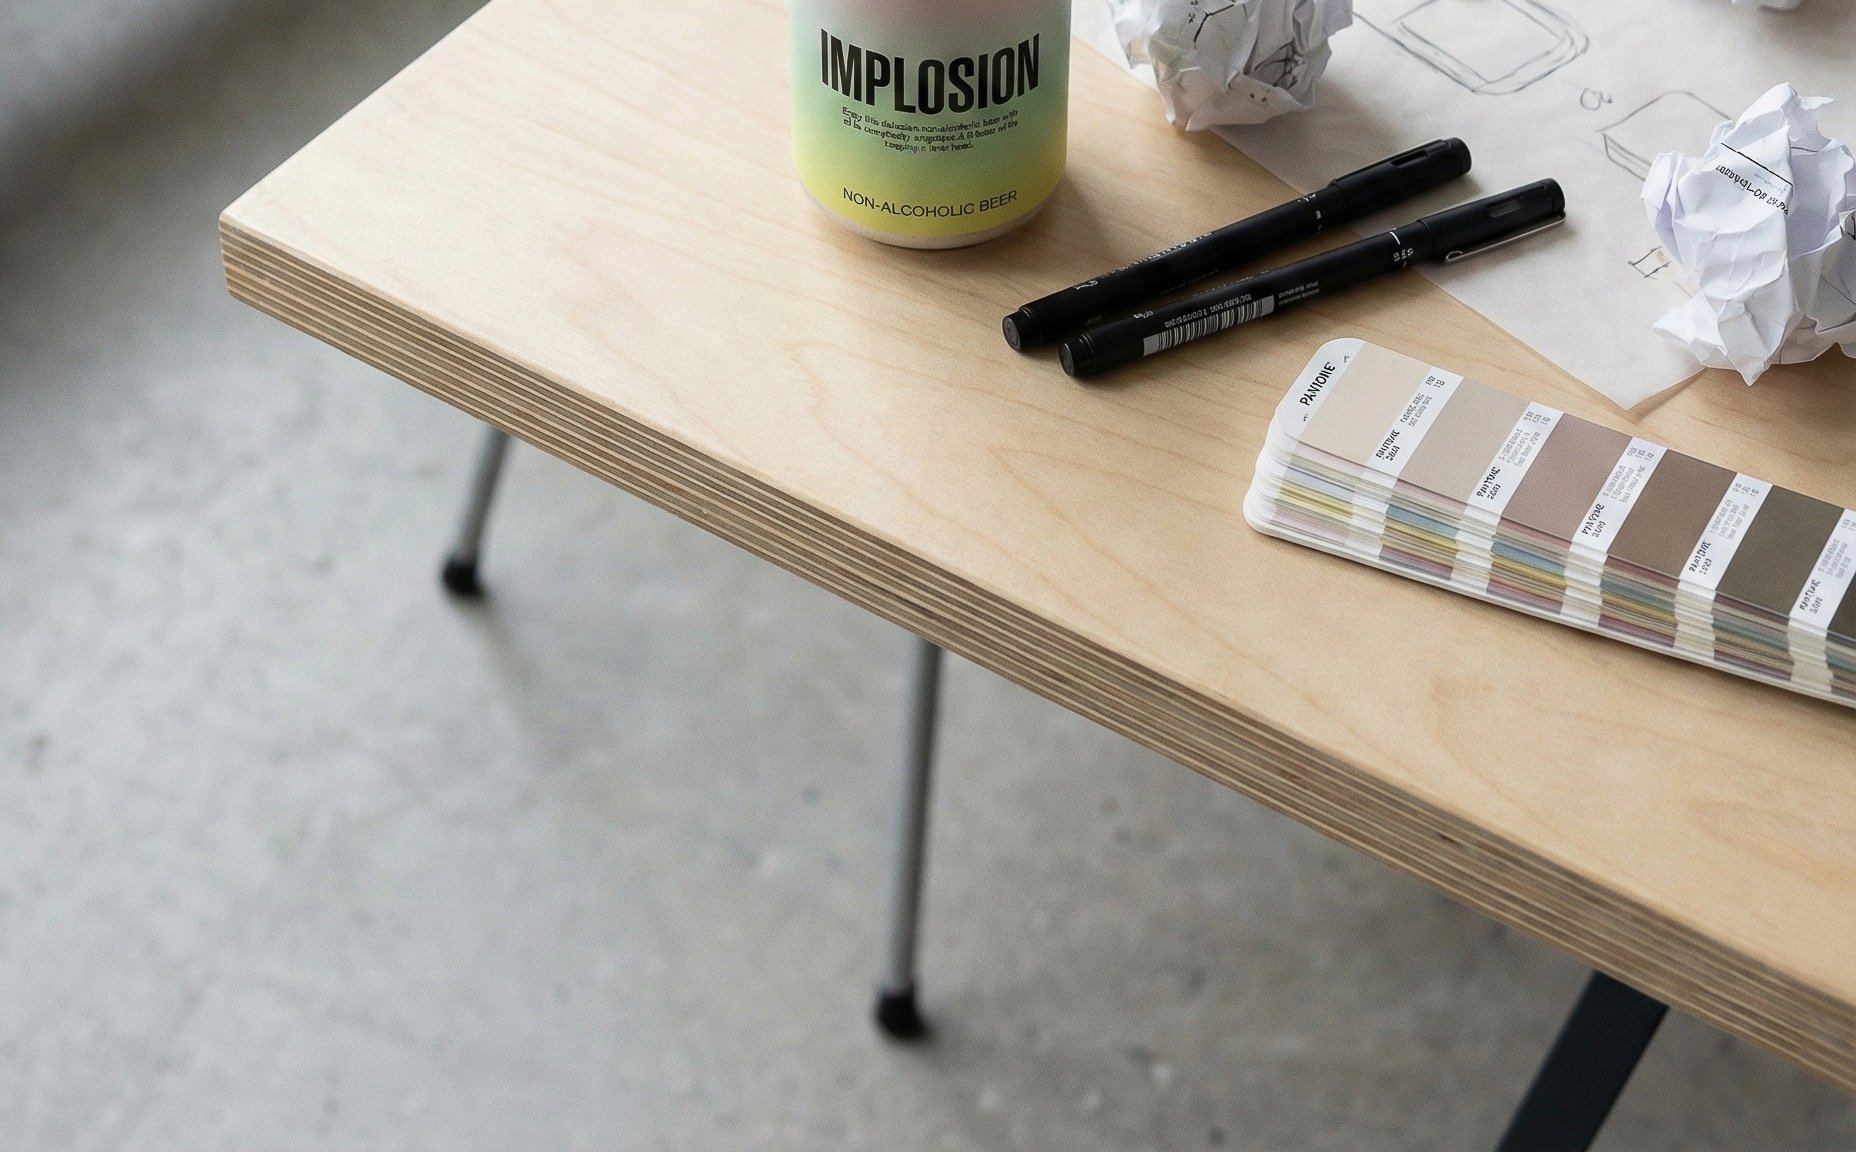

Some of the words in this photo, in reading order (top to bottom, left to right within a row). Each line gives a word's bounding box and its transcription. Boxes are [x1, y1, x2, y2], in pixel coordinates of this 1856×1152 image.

[820, 27, 1041, 115] IMPLOSION
[842, 186, 976, 218] NON-ALCOHOLIC
[978, 189, 1019, 213] BEER
